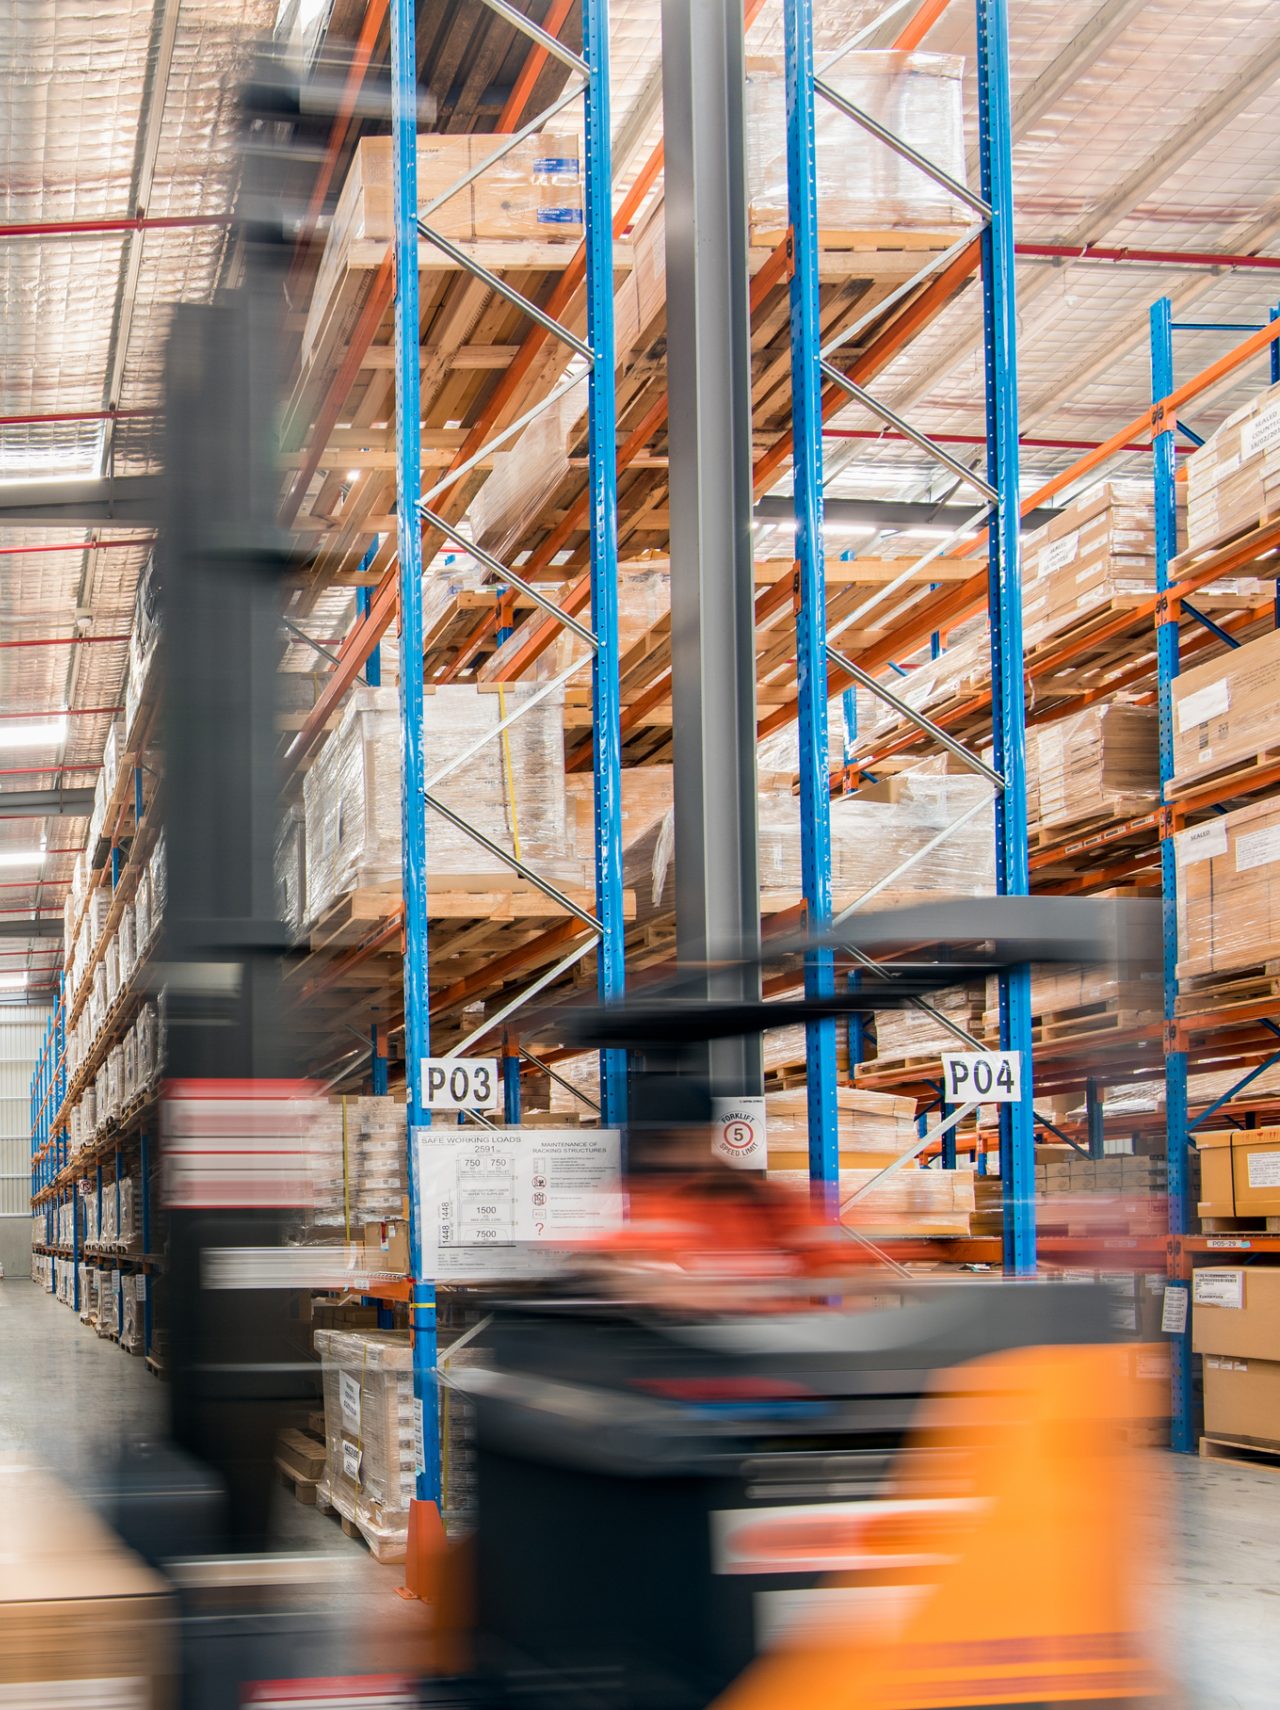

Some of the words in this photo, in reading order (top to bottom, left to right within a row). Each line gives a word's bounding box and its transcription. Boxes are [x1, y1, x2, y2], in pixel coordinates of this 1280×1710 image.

[1190, 830, 1211, 841] SEALED
[950, 1060, 1014, 1095] P04
[428, 1067, 491, 1102] P03
[721, 1113, 755, 1124] FORKLIFT
[734, 1128, 744, 1142] 5
[474, 1145, 495, 1153] 2591
[720, 1142, 740, 1156] SPEED
[742, 1142, 759, 1156] LIMIT
[465, 1159, 480, 1167] 750
[476, 1206, 497, 1214] 1500
[475, 1230, 497, 1238] 7500
